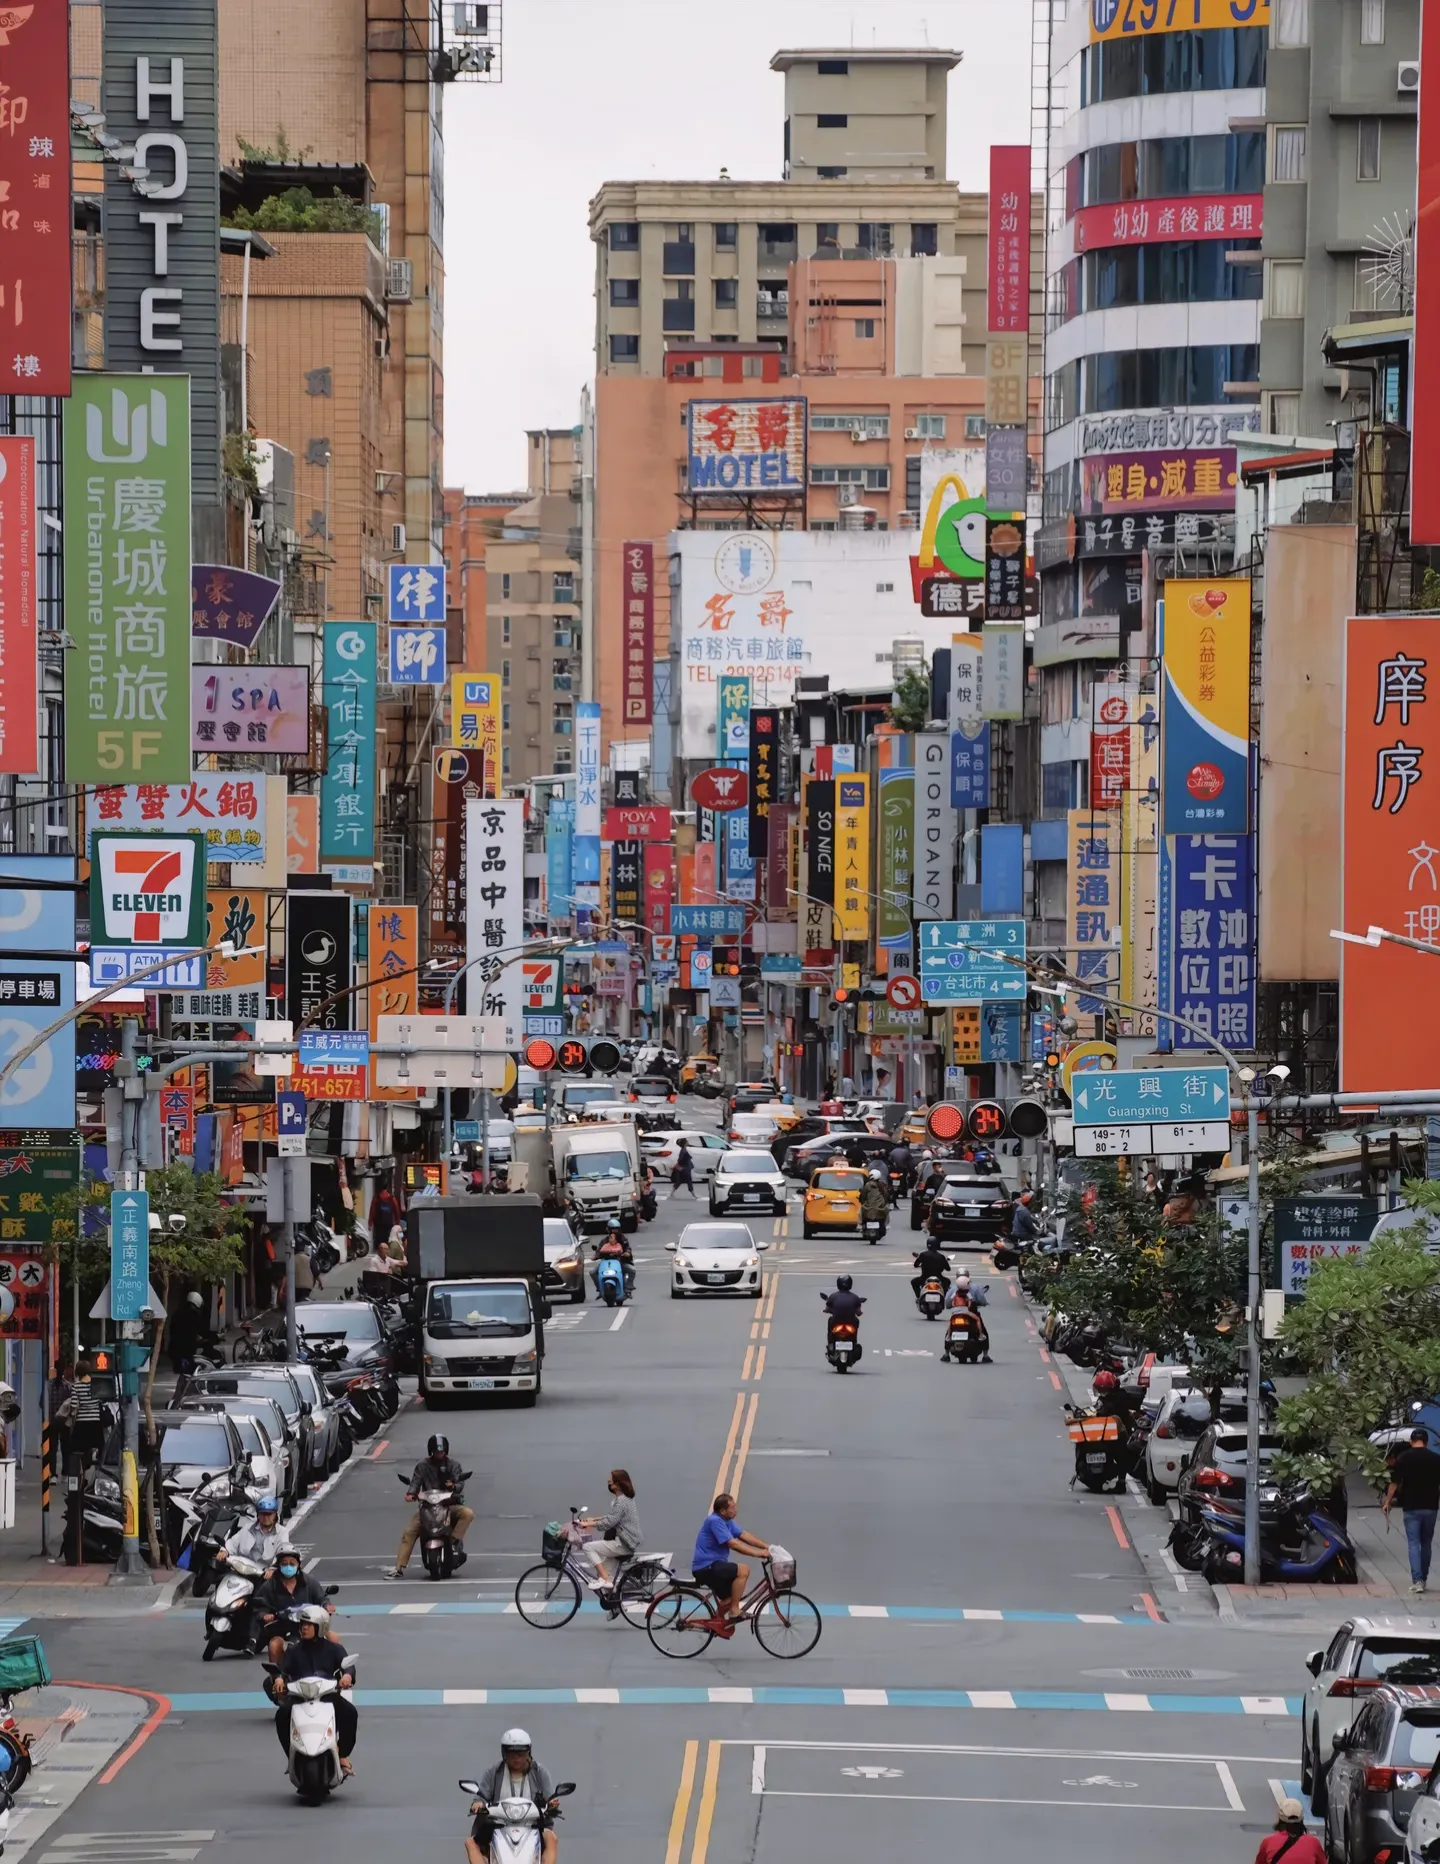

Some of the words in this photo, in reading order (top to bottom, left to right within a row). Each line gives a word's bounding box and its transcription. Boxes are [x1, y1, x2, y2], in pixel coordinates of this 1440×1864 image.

[134, 56, 188, 373] HOTE
[1001, 192, 1018, 232] 幼幼
[692, 451, 799, 488] MOTEL
[86, 477, 106, 625] Urbanone
[112, 477, 168, 722] 慶城商旅
[394, 567, 438, 682] 律師
[687, 637, 804, 661] 商務汽車旅館
[87, 633, 107, 721] Hotel
[1199, 626, 1216, 702] 公益彩券
[232, 687, 281, 712] SPA
[631, 701, 642, 716] P
[97, 731, 162, 770] 5F
[332, 668, 368, 847] 合作金庫銀行
[579, 727, 597, 806] 千山淨水
[620, 811, 657, 823] POYA
[818, 811, 832, 831] SO
[926, 744, 943, 909] GIORDANO
[818, 836, 832, 873] NICE
[115, 850, 181, 942] 7
[806, 906, 824, 949] 皮鞋
[1007, 929, 1017, 943] 3
[134, 955, 159, 967] ATM
[944, 976, 987, 990] 台北市
[989, 980, 999, 994] 4
[302, 1034, 341, 1050] 王威元
[564, 1043, 584, 1065] 34
[1093, 1074, 1209, 1102] 光興街
[282, 1102, 295, 1125] P
[976, 1108, 999, 1134] 34
[1107, 1104, 1169, 1119] Guangxing
[1180, 1102, 1195, 1116] St.
[121, 1209, 138, 1278] 正義南路
[116, 1278, 145, 1292] Zheng-
[126, 1291, 134, 1302] S
[117, 1304, 132, 1315] Rd.
